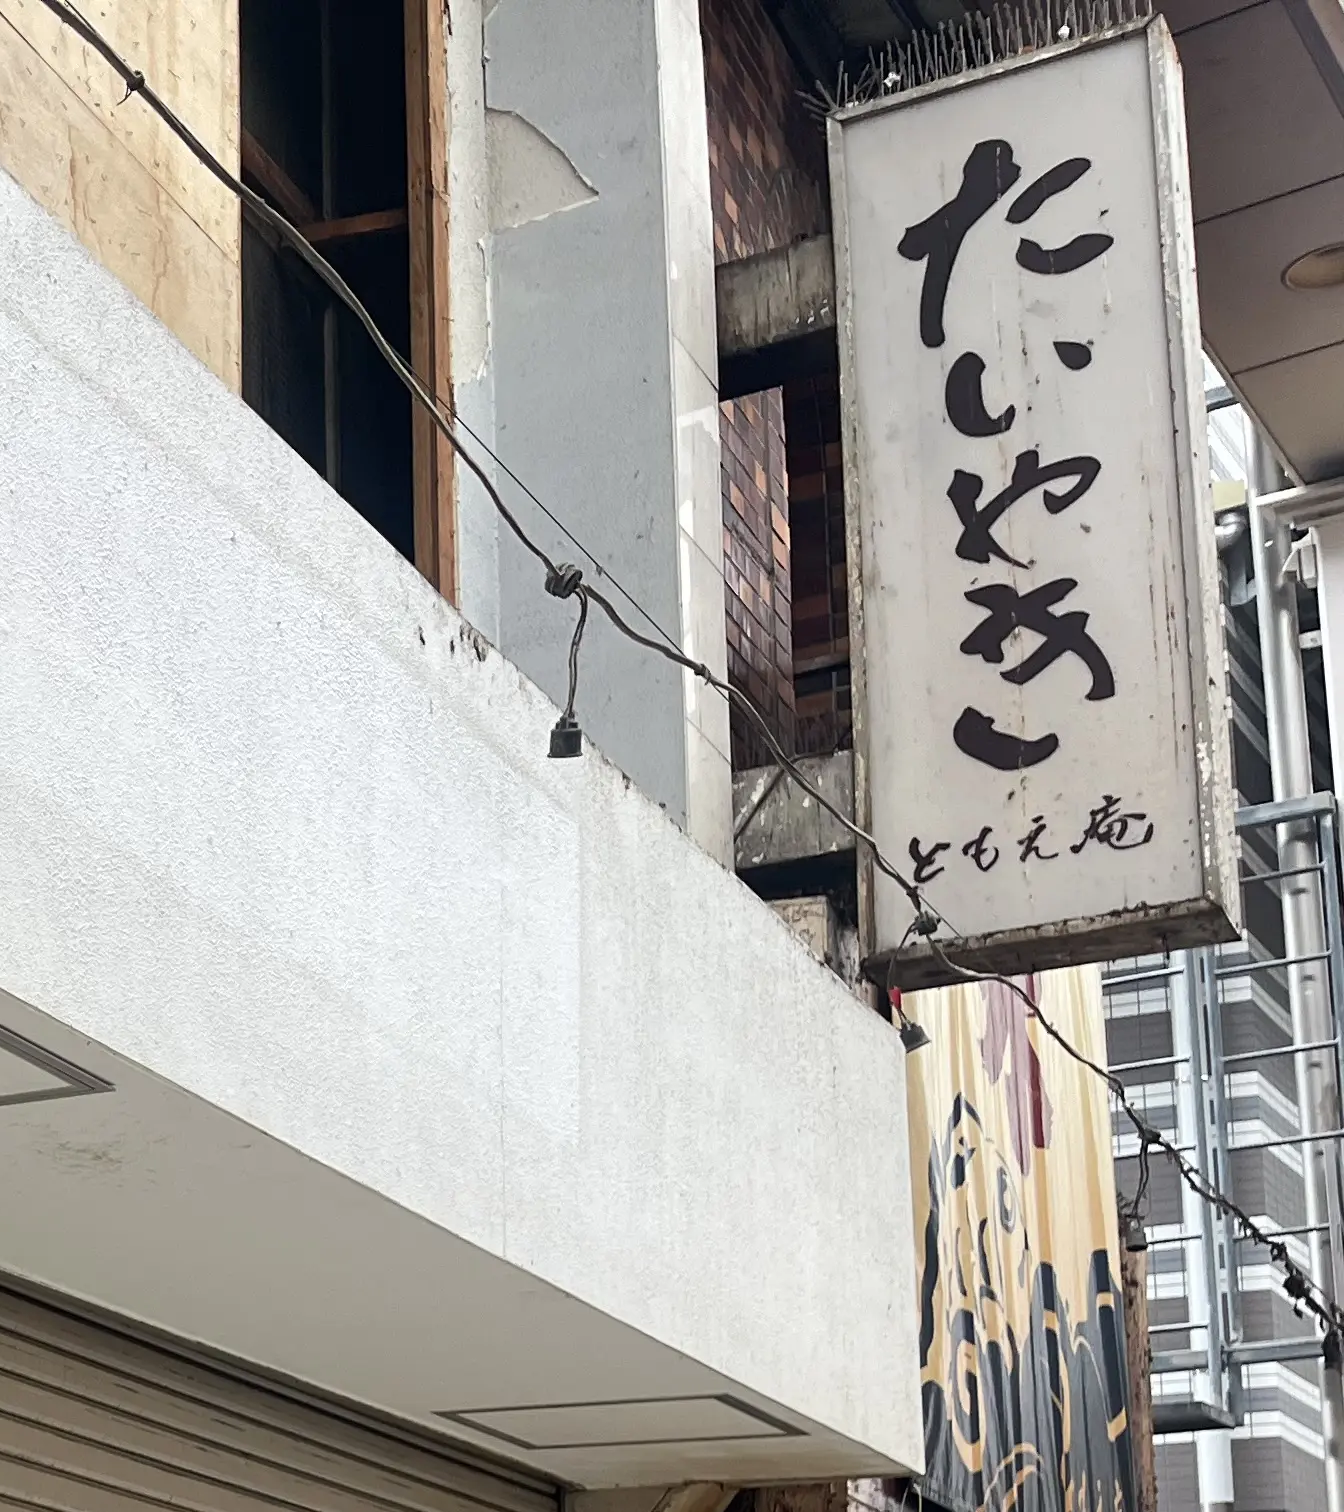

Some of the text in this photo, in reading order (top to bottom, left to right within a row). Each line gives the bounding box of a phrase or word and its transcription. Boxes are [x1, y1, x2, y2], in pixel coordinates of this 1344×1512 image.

[897, 138, 1115, 771] たいやき
[908, 795, 1154, 884] ともえ庵
